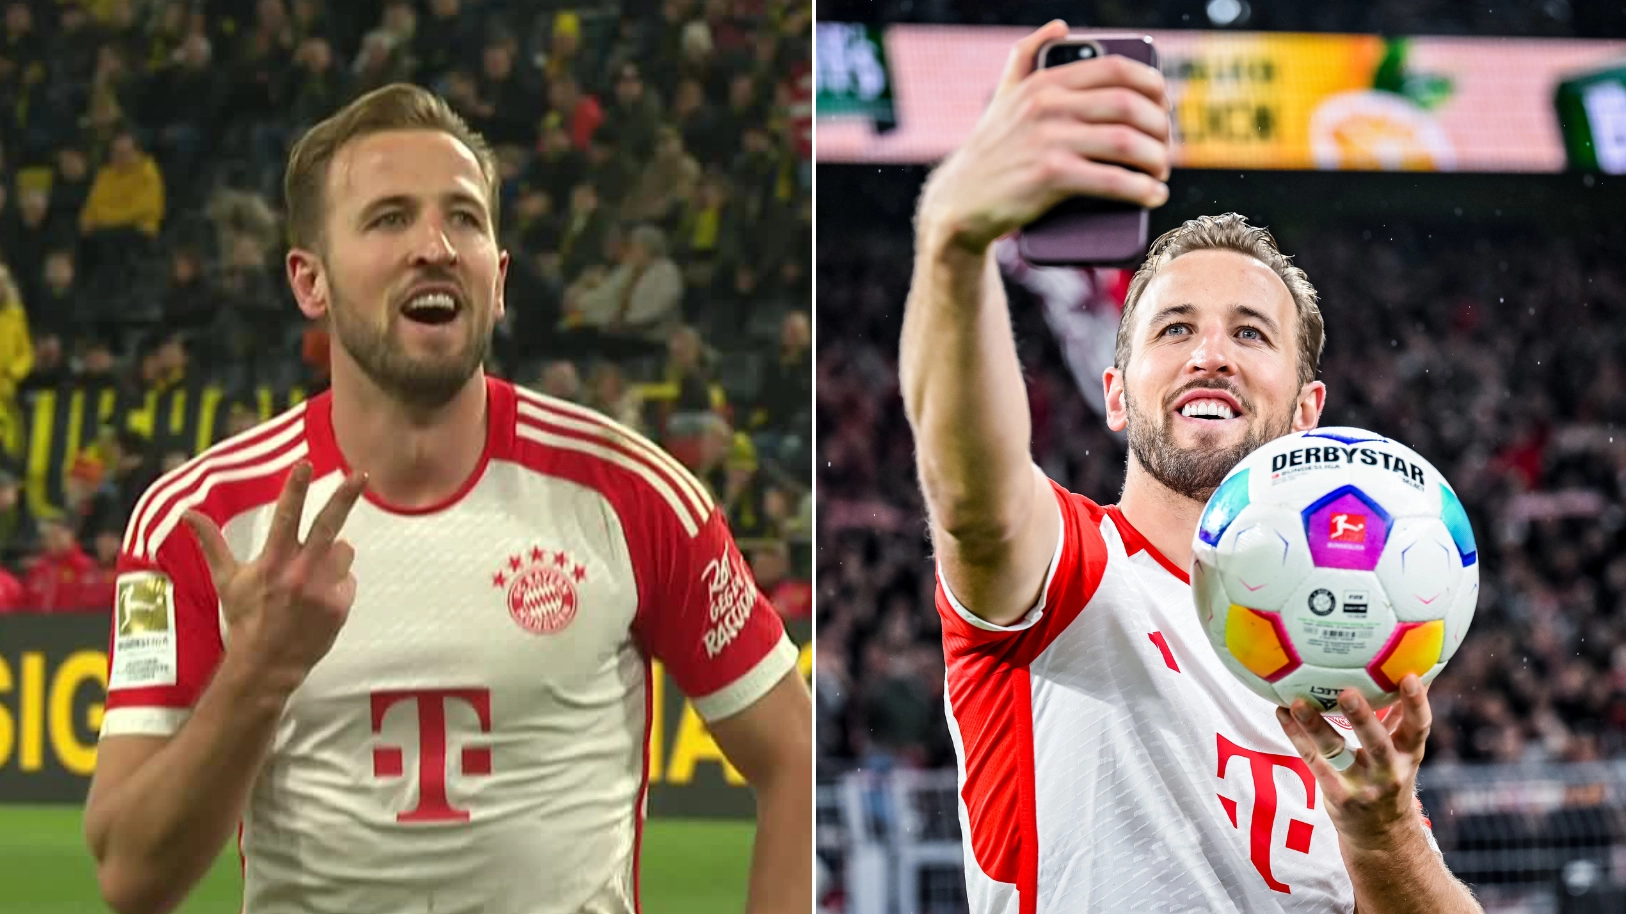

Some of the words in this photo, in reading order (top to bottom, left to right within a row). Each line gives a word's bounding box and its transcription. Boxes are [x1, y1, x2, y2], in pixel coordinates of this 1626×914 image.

[1272, 446, 1425, 486] DERBYSTAR
[370, 687, 491, 823] T
[1216, 732, 1316, 894] T
